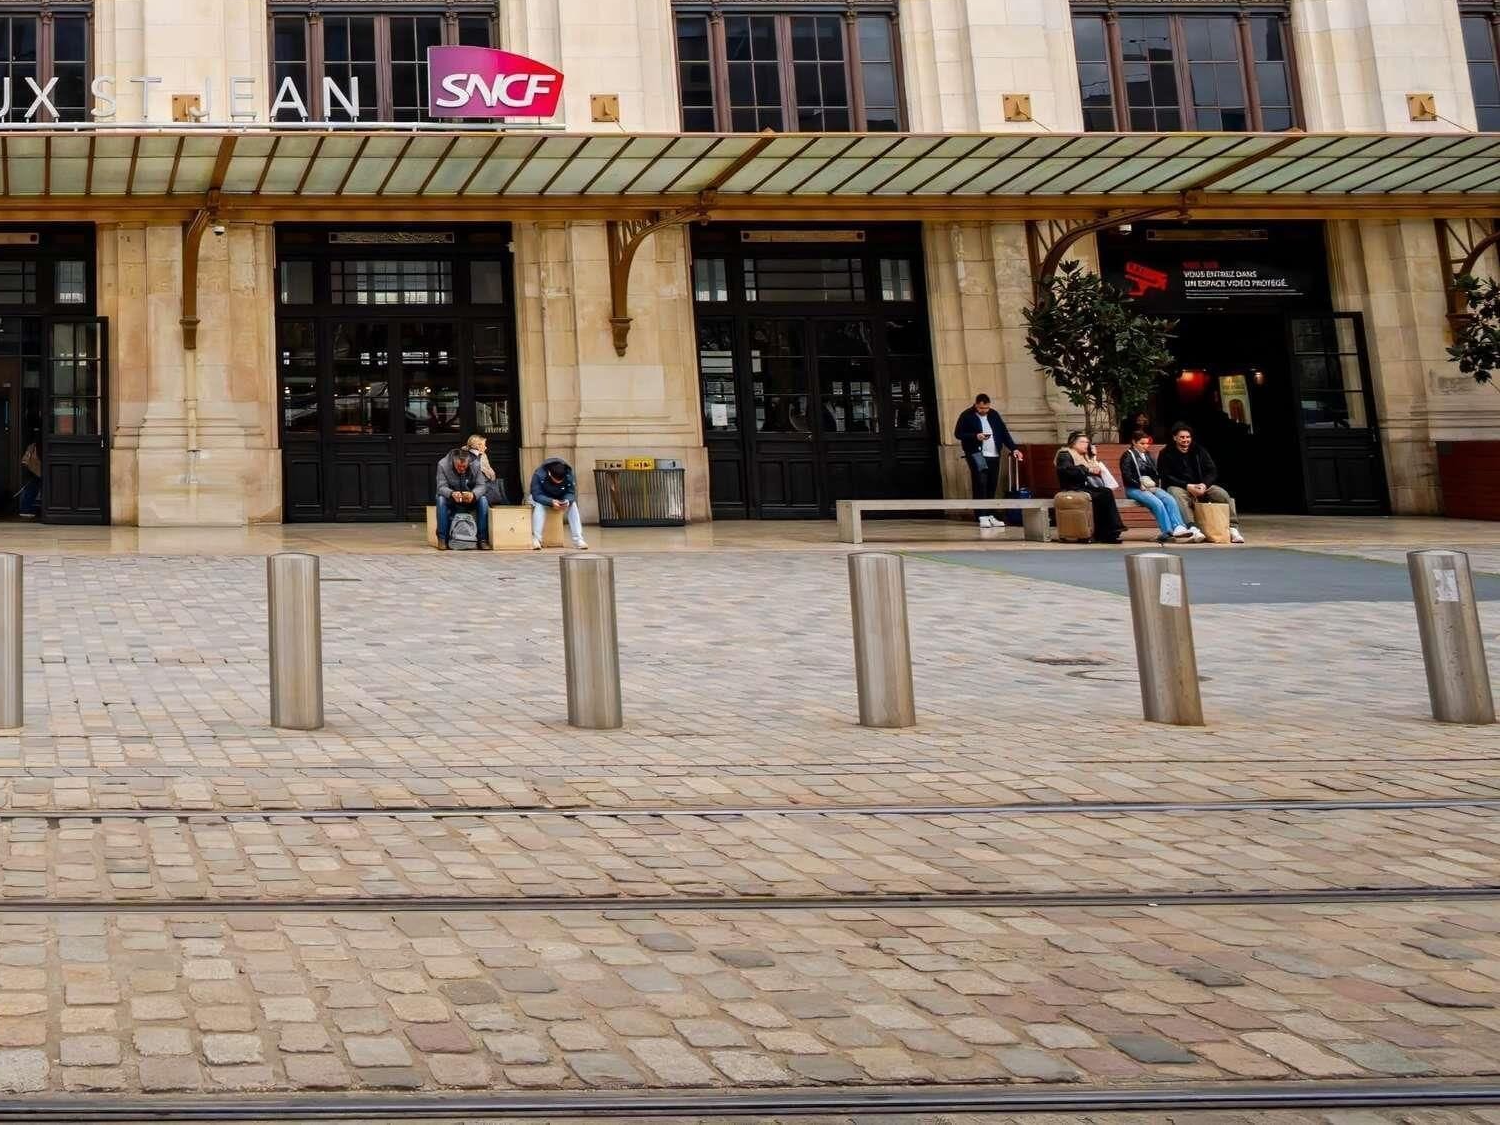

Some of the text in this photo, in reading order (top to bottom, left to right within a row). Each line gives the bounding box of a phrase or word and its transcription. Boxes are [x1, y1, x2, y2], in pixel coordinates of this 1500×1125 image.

[90, 75, 163, 119] ST
[187, 75, 361, 119] JEAN
[436, 73, 557, 108] SNCF
